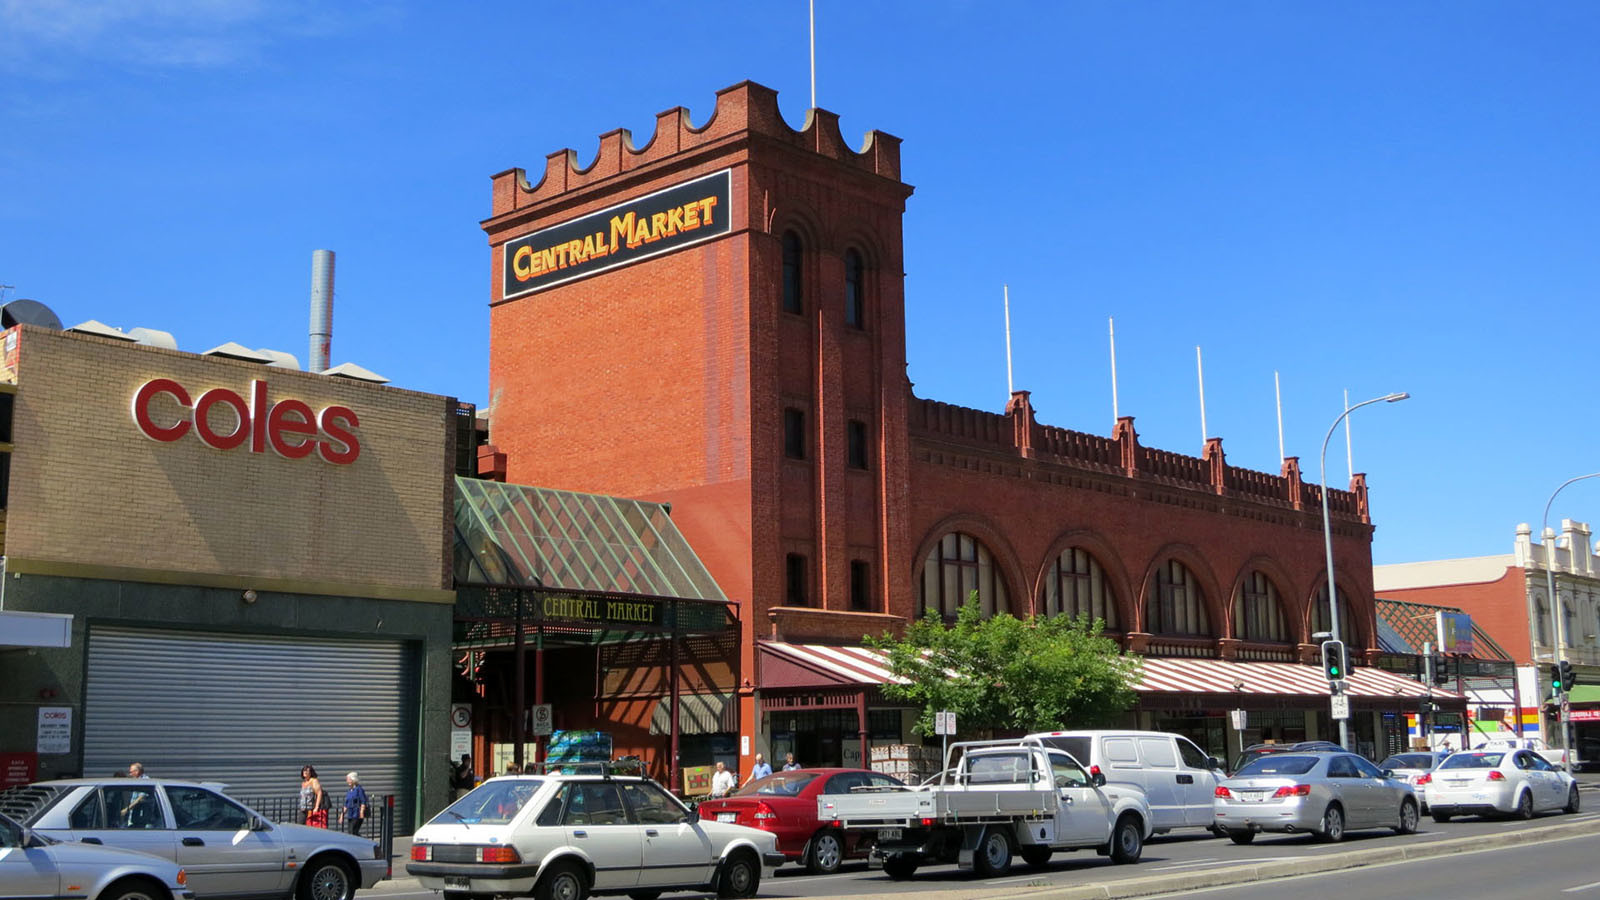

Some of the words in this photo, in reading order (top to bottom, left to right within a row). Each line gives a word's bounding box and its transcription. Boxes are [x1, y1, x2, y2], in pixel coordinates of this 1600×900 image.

[513, 231, 609, 282] CENTRAL
[610, 196, 717, 254] MARKET
[131, 377, 361, 465] coles
[543, 597, 600, 619] CENTRAL
[606, 601, 655, 622] MARKET
